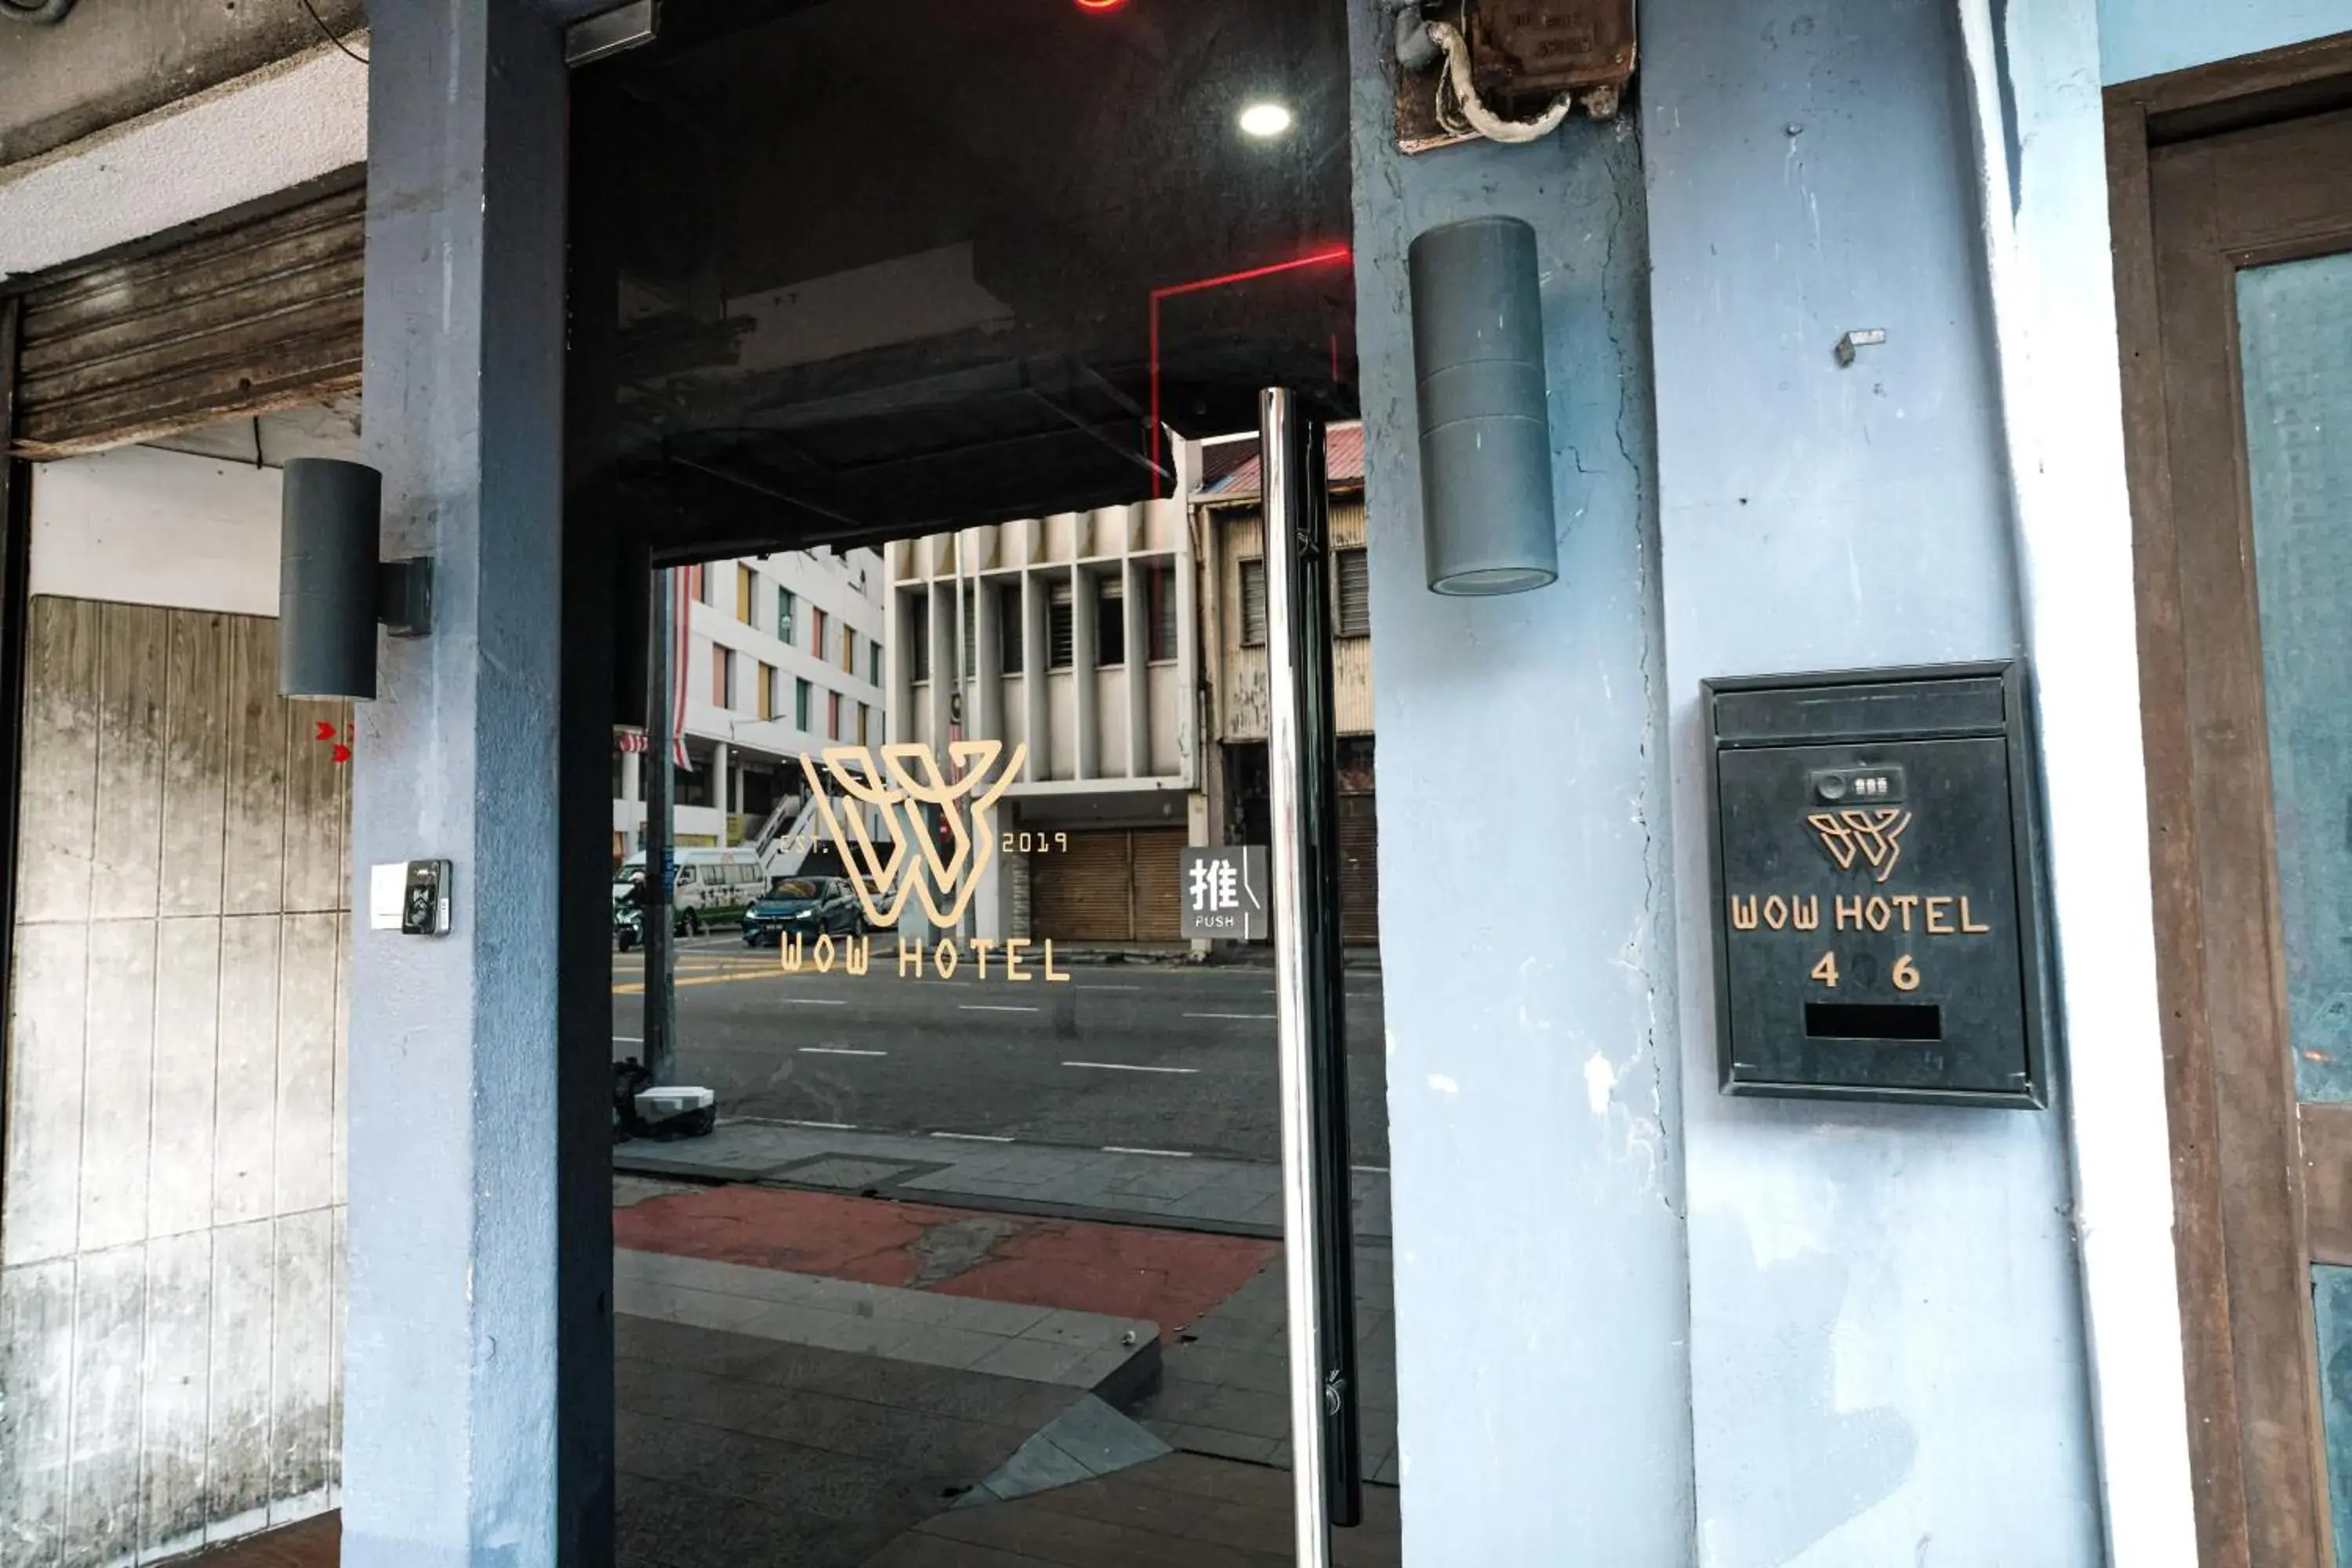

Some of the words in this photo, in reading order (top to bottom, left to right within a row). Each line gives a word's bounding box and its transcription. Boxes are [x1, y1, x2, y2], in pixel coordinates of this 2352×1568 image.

[780, 835, 829, 854] EST.
[1003, 833, 1066, 852] 2019
[1189, 858, 1239, 912] 推
[1196, 915, 1234, 927] PUSH
[1731, 895, 1819, 930] WOW
[1835, 895, 1991, 934] HOTEL
[780, 931, 869, 976] WOW
[898, 936, 1070, 981] HOTEL
[1810, 951, 1839, 988] 4
[1892, 953, 1921, 991] 6
